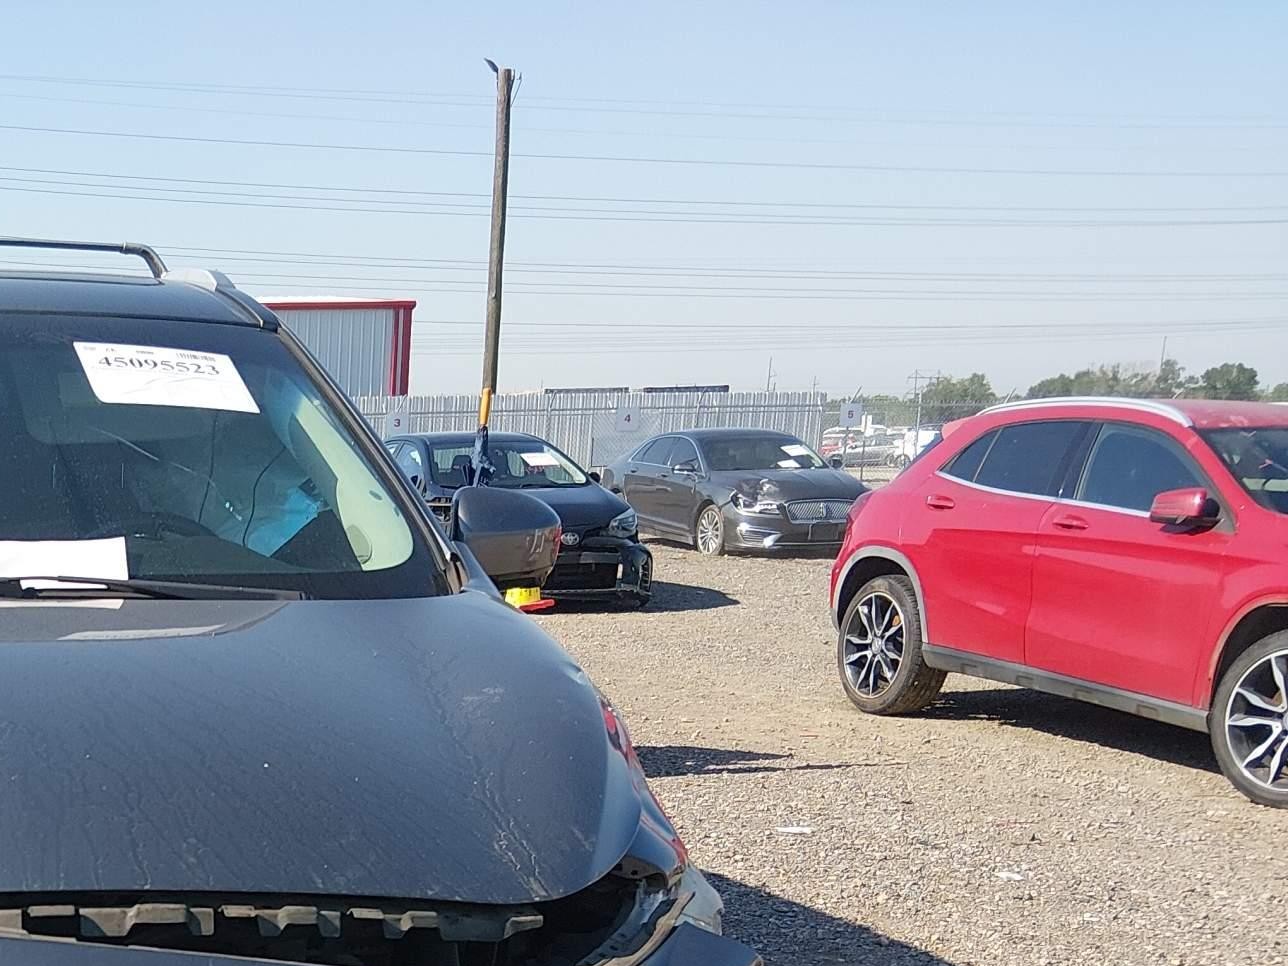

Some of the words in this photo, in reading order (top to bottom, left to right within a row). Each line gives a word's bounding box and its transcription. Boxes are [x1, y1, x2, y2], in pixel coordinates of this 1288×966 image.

[98, 355, 220, 376] 45095523
[624, 413, 631, 423] 4
[847, 410, 854, 419] 5
[393, 418, 401, 428] 3
